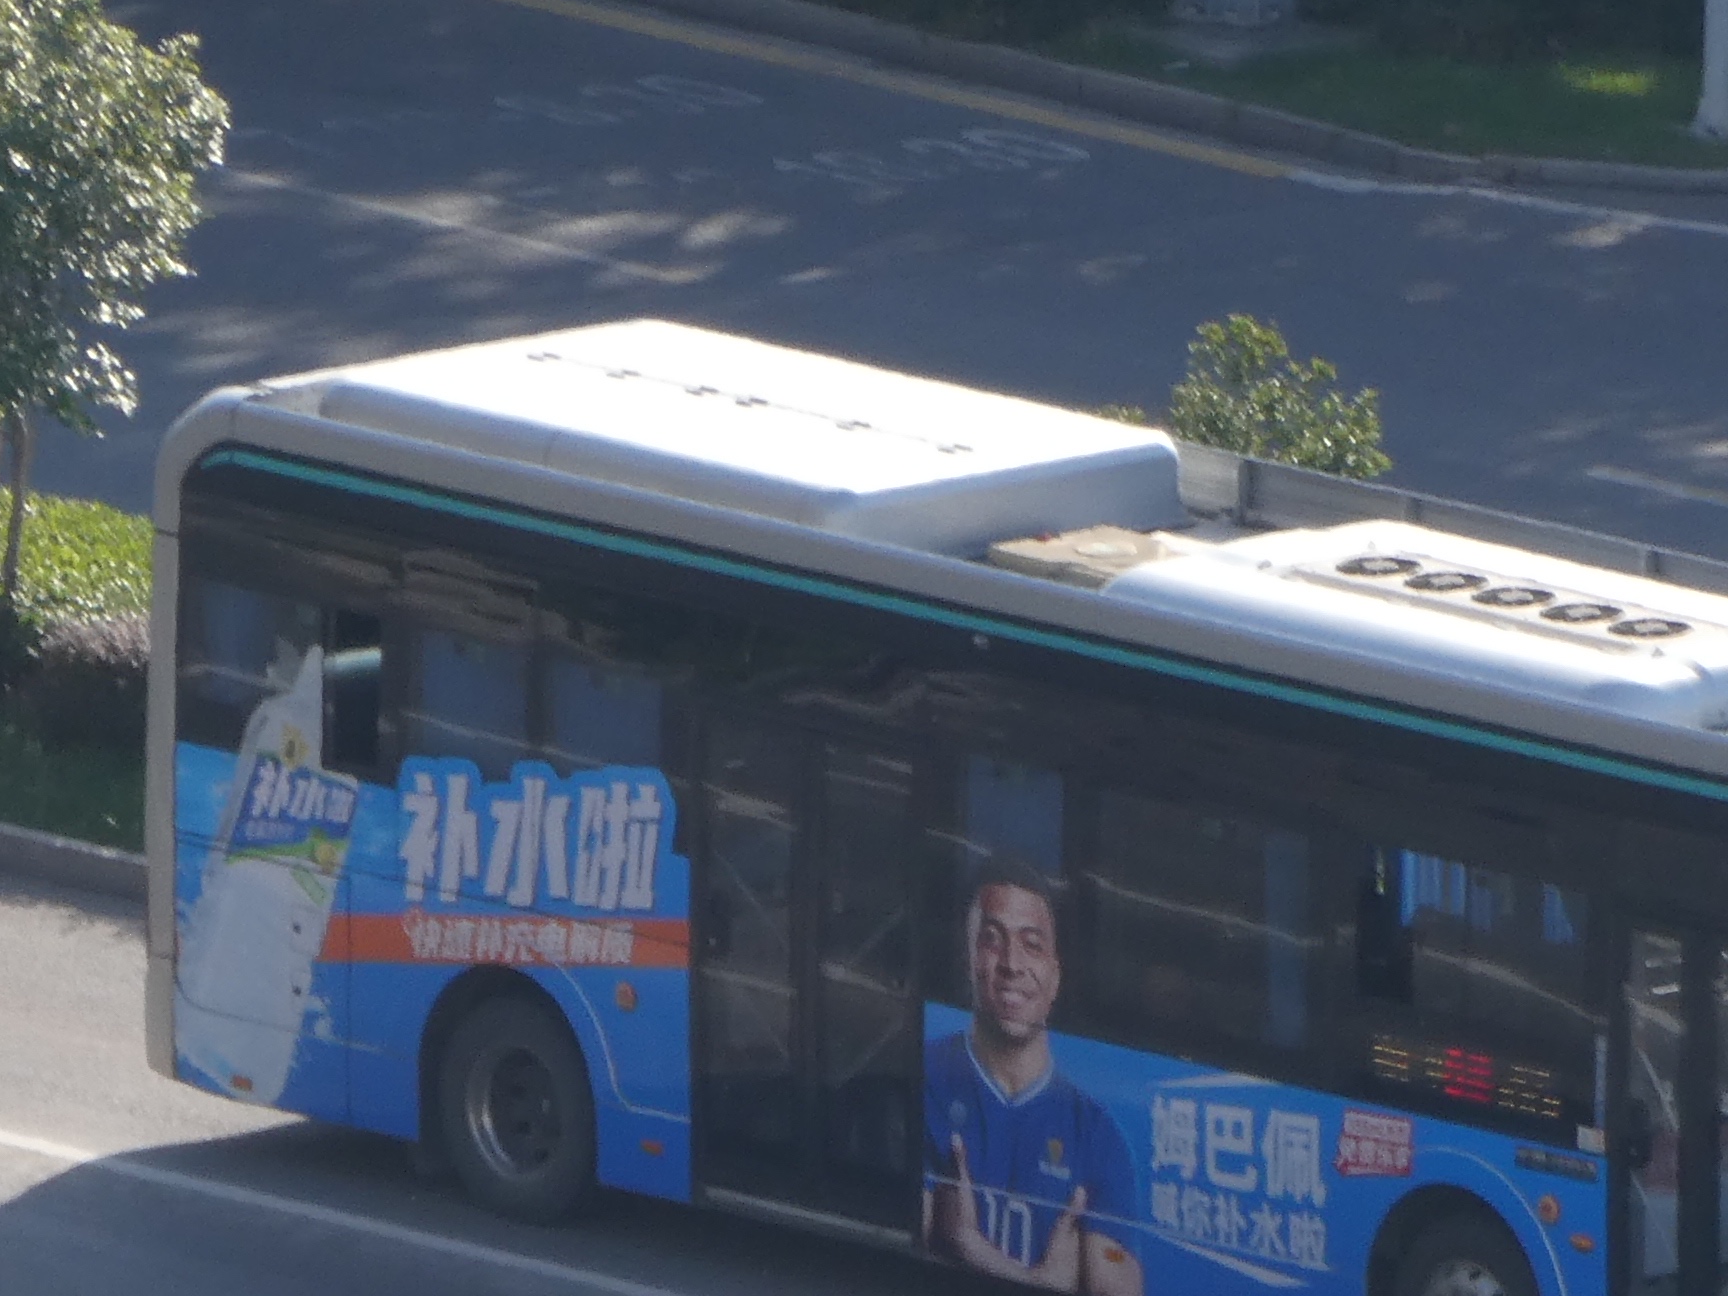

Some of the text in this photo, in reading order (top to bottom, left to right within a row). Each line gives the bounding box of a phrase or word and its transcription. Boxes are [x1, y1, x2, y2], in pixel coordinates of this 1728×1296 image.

[398, 772, 663, 909] 补水啦
[1151, 1094, 1328, 1208] 姆巴佩
